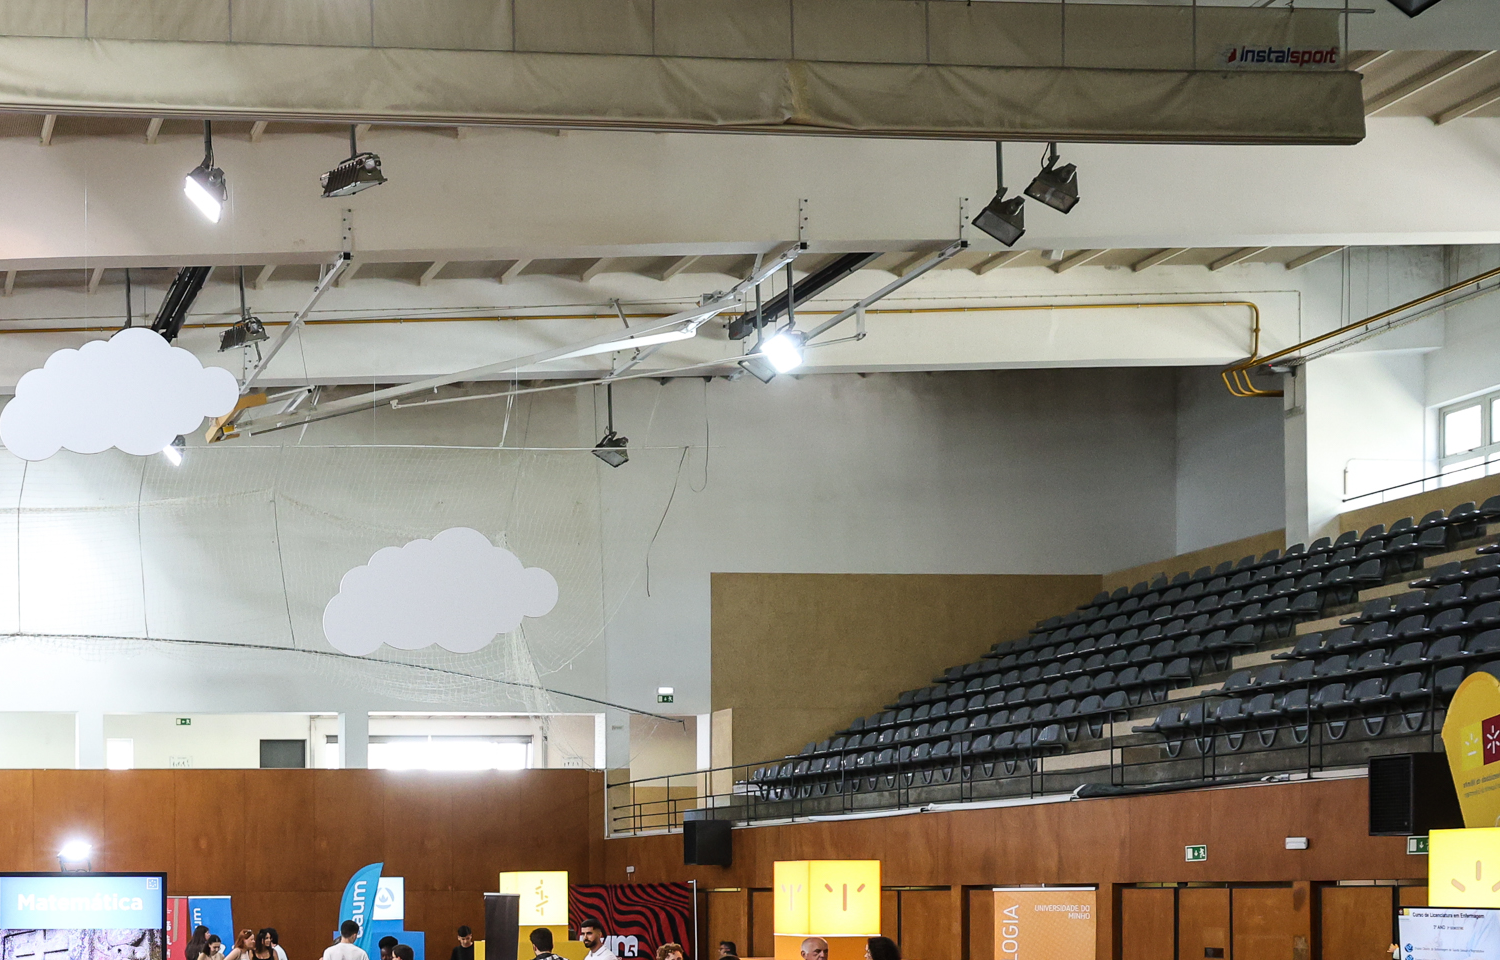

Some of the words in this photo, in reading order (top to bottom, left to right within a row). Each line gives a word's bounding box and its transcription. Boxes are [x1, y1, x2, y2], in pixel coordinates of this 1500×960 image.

[1239, 46, 1338, 67] instalsport
[17, 892, 143, 911] Matemática
[1034, 904, 1079, 912] UNIVERSIDADE
[1080, 904, 1091, 912] DO
[1068, 912, 1091, 920] MINHO
